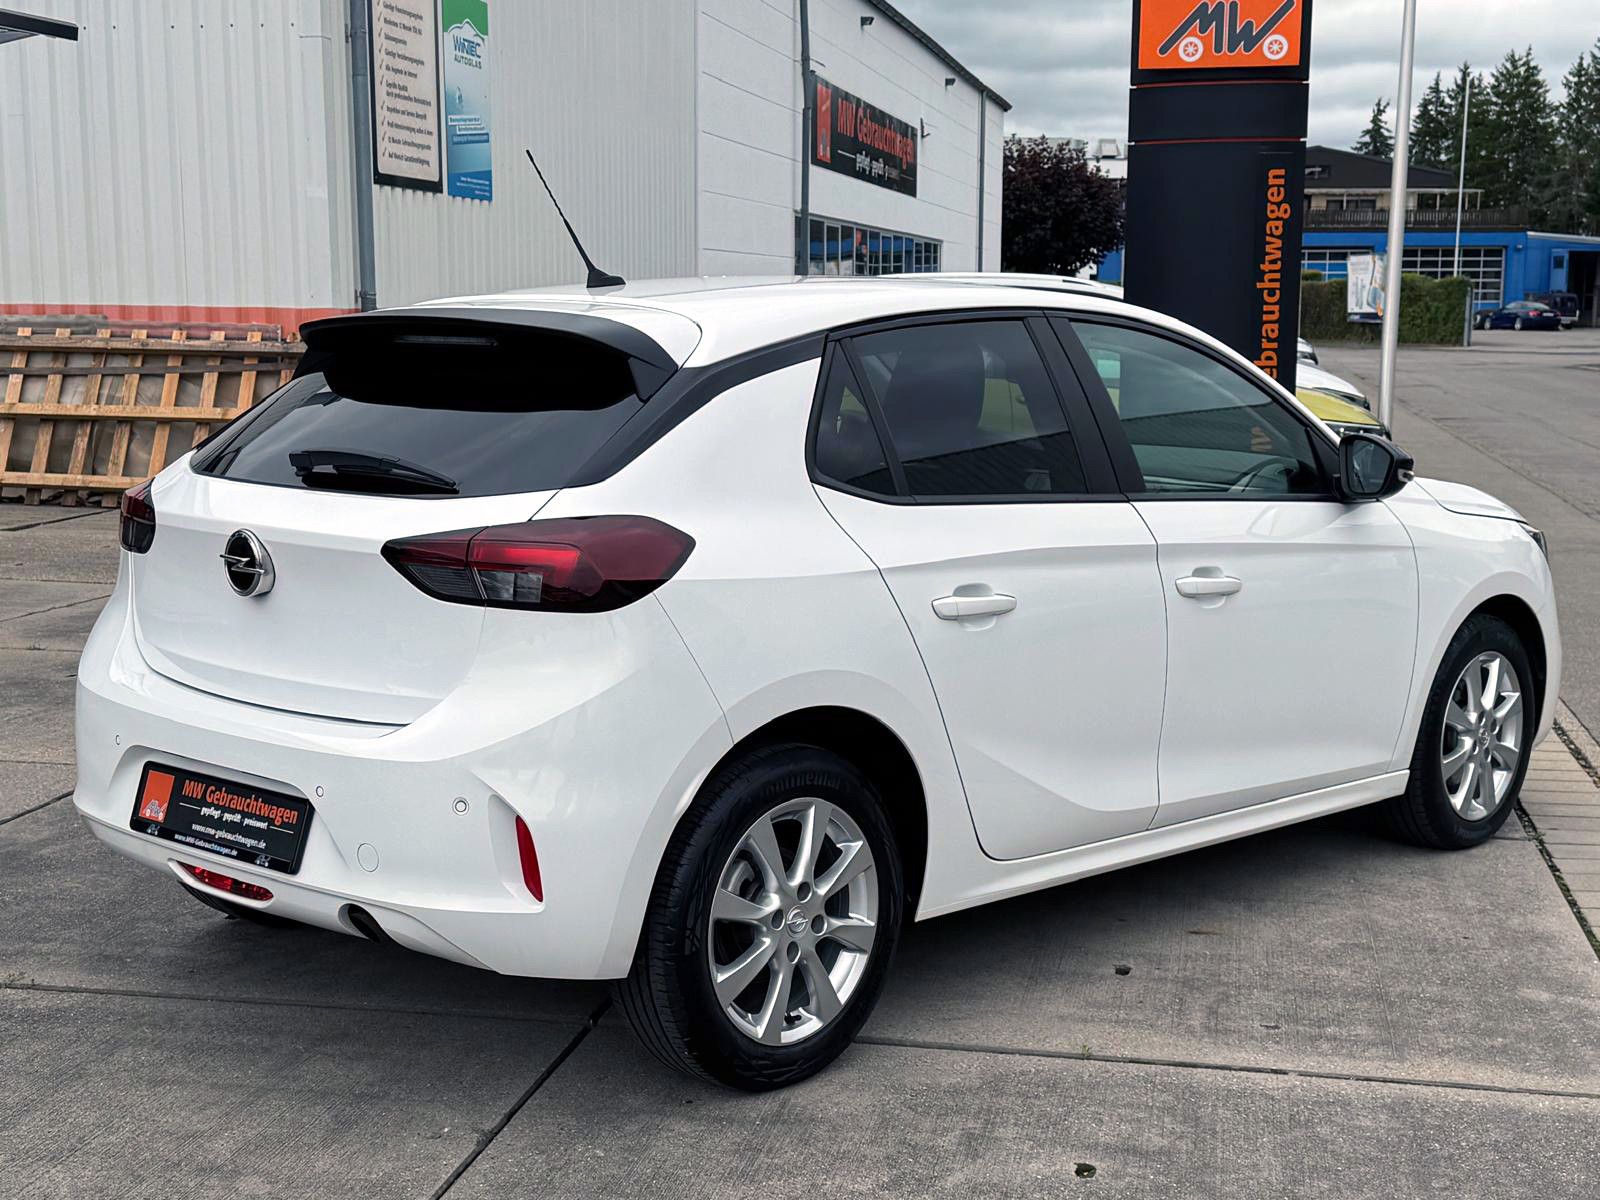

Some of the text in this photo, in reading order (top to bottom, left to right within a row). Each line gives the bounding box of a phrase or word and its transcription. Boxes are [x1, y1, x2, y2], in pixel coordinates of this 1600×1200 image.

[1157, 0, 1297, 56] MW
[454, 54, 482, 70] AUTOGLAS
[837, 98, 914, 170] MW Gebrauchtwagen
[1253, 168, 1290, 380] ebrauchtwagen
[182, 779, 299, 826] MW Gebrauchtwagen
[201, 806, 221, 819] gepflegt
[243, 818, 268, 830] preiswert
